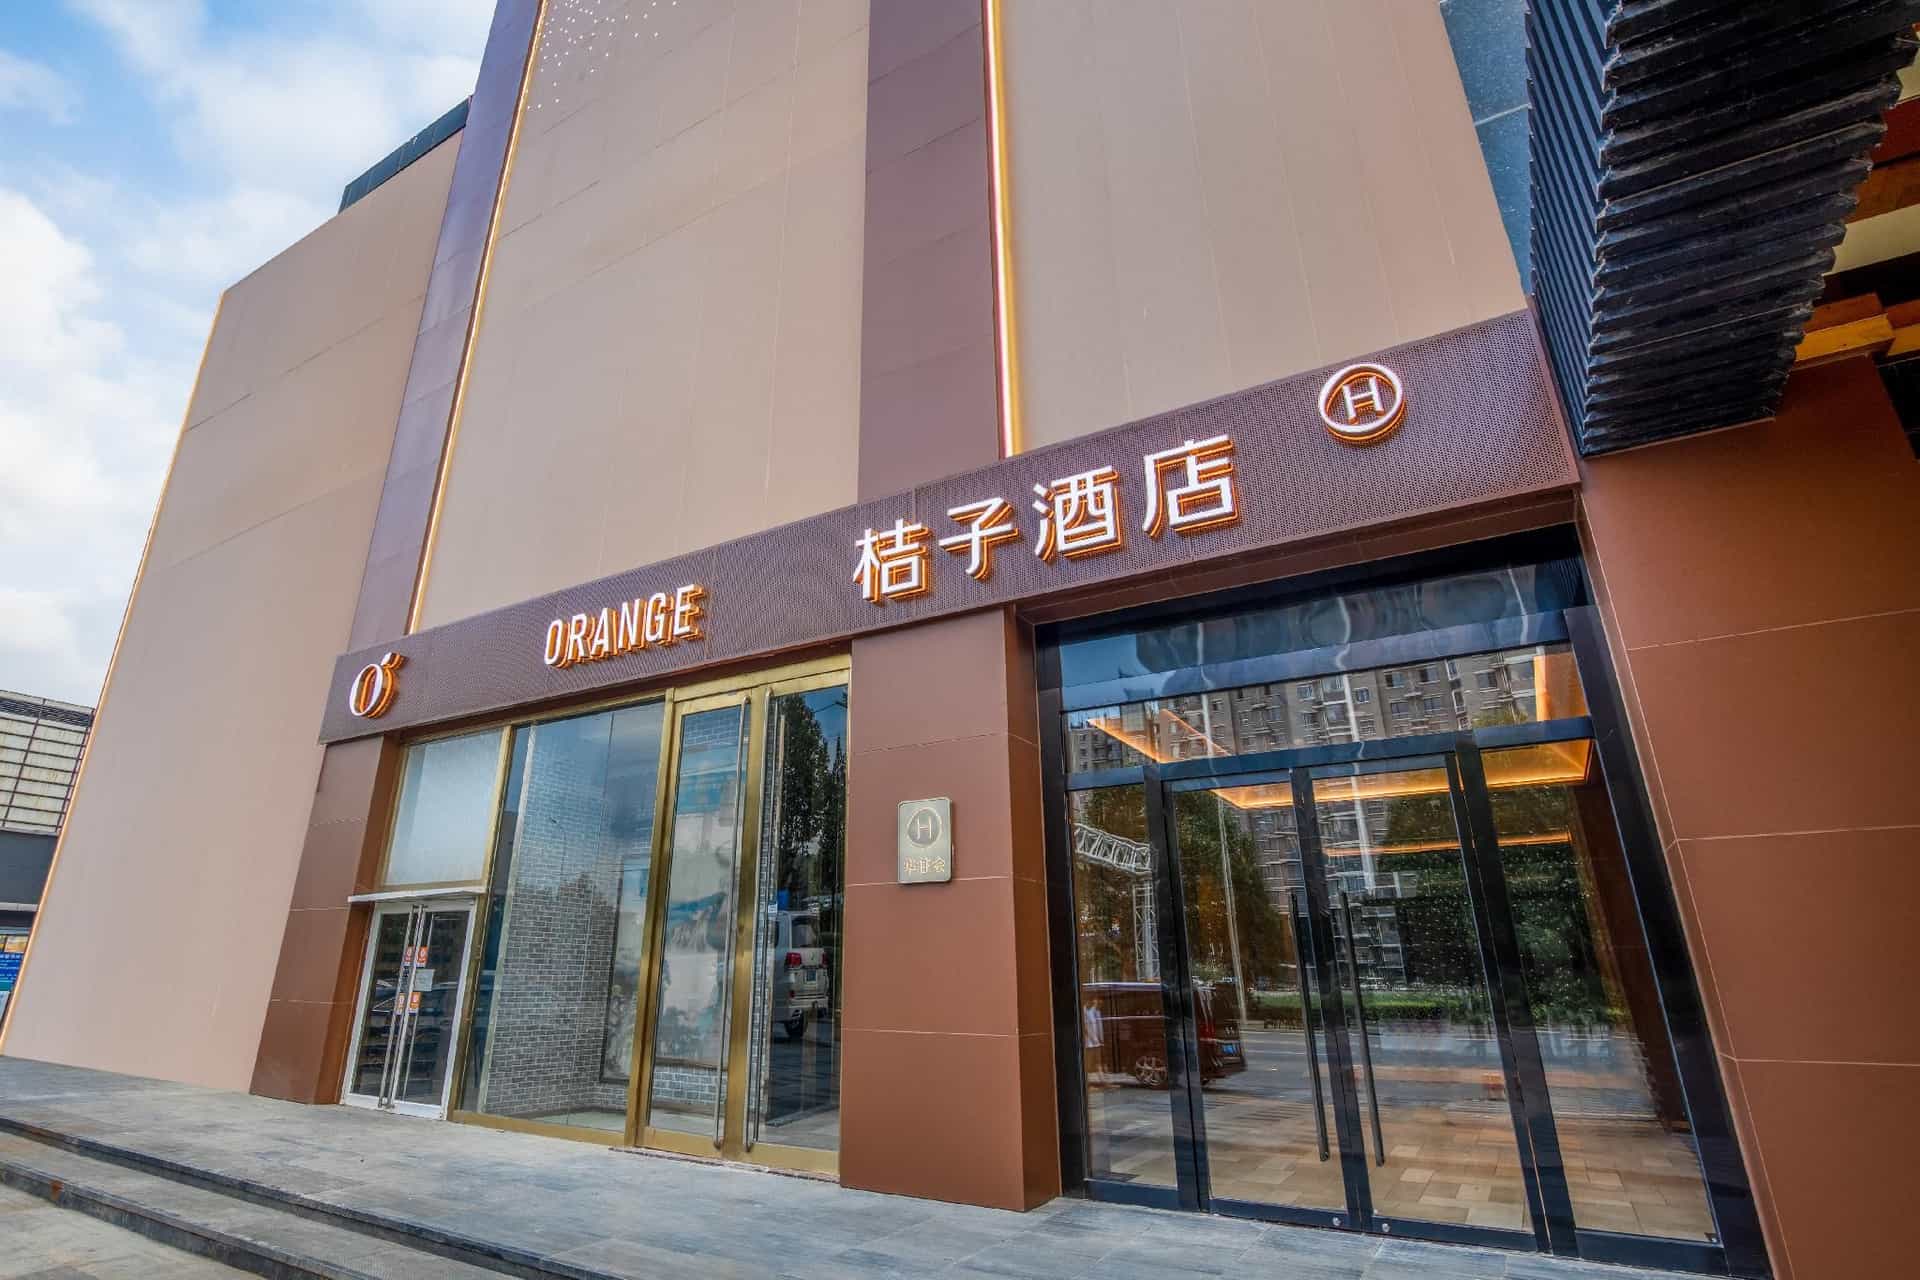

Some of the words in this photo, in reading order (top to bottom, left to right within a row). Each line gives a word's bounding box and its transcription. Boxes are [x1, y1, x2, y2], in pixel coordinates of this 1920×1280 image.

[1338, 375, 1386, 426] H
[853, 434, 1238, 602] 桔子酒店
[543, 583, 706, 668] ORANGE
